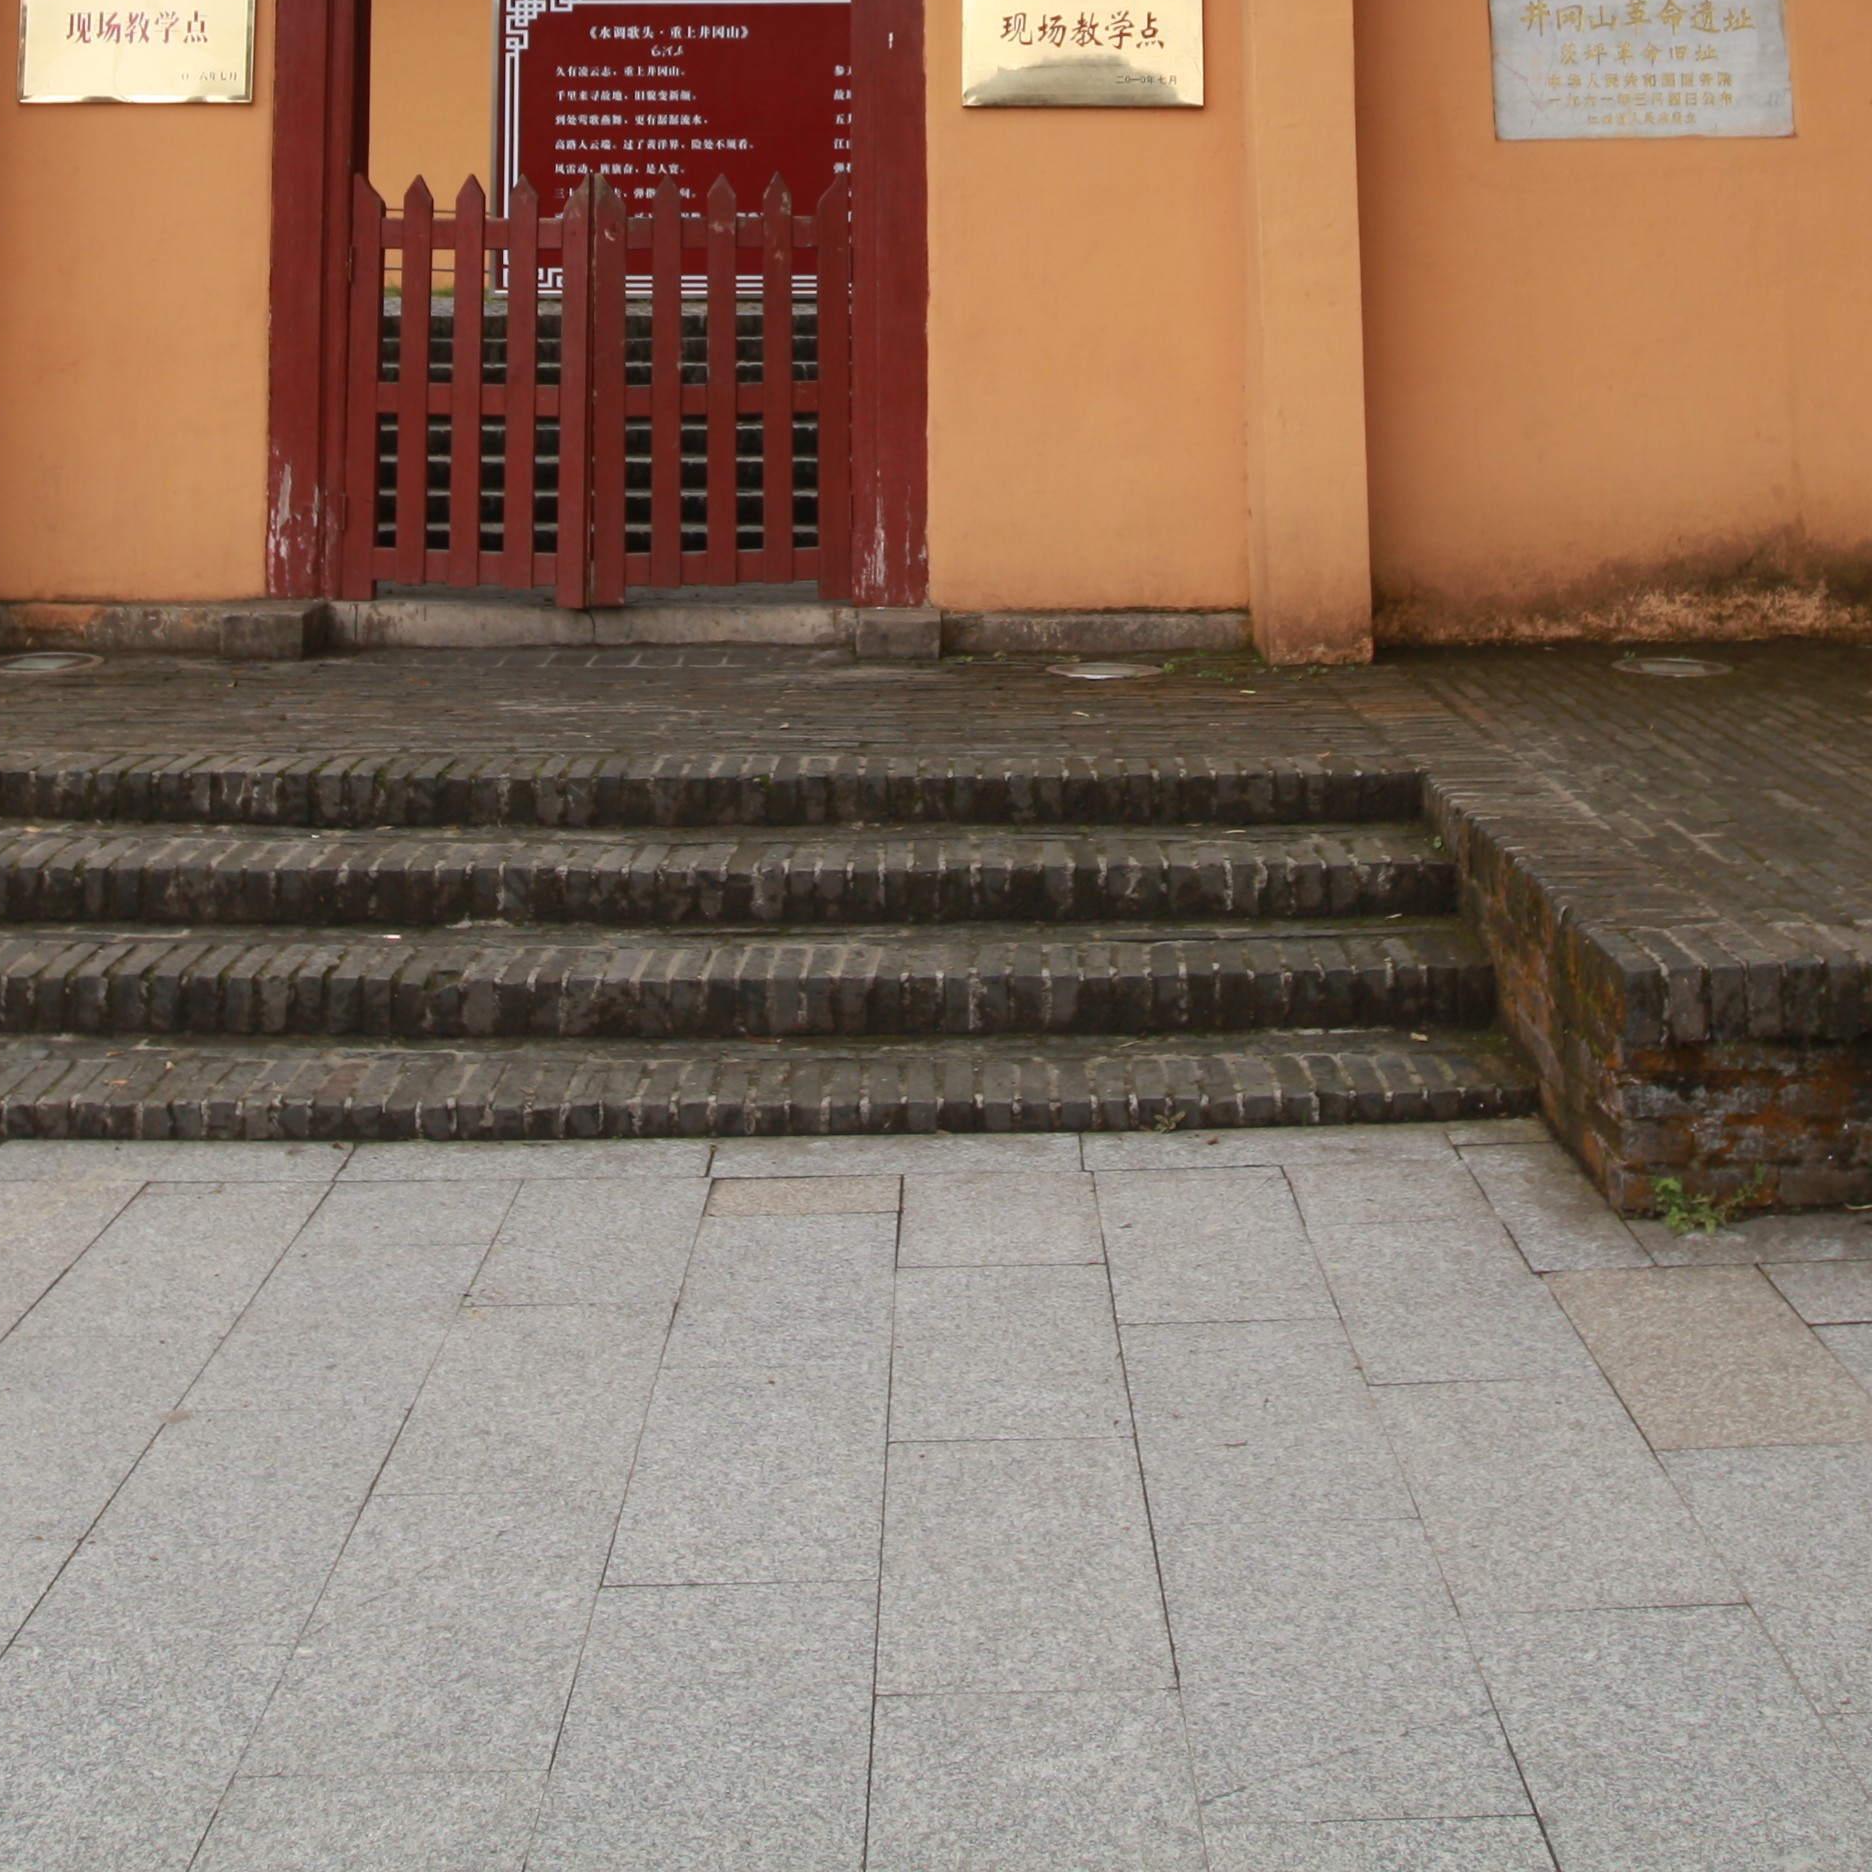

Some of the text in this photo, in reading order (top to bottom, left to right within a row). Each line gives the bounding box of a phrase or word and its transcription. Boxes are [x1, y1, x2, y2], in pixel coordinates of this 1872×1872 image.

[66, 10, 209, 45] 现场教学点
[999, 10, 1165, 50] 现场教学点
[1560, 41, 1720, 65] 茨坪革命旧址
[1547, 71, 1734, 89] 中华人民共和国国务院
